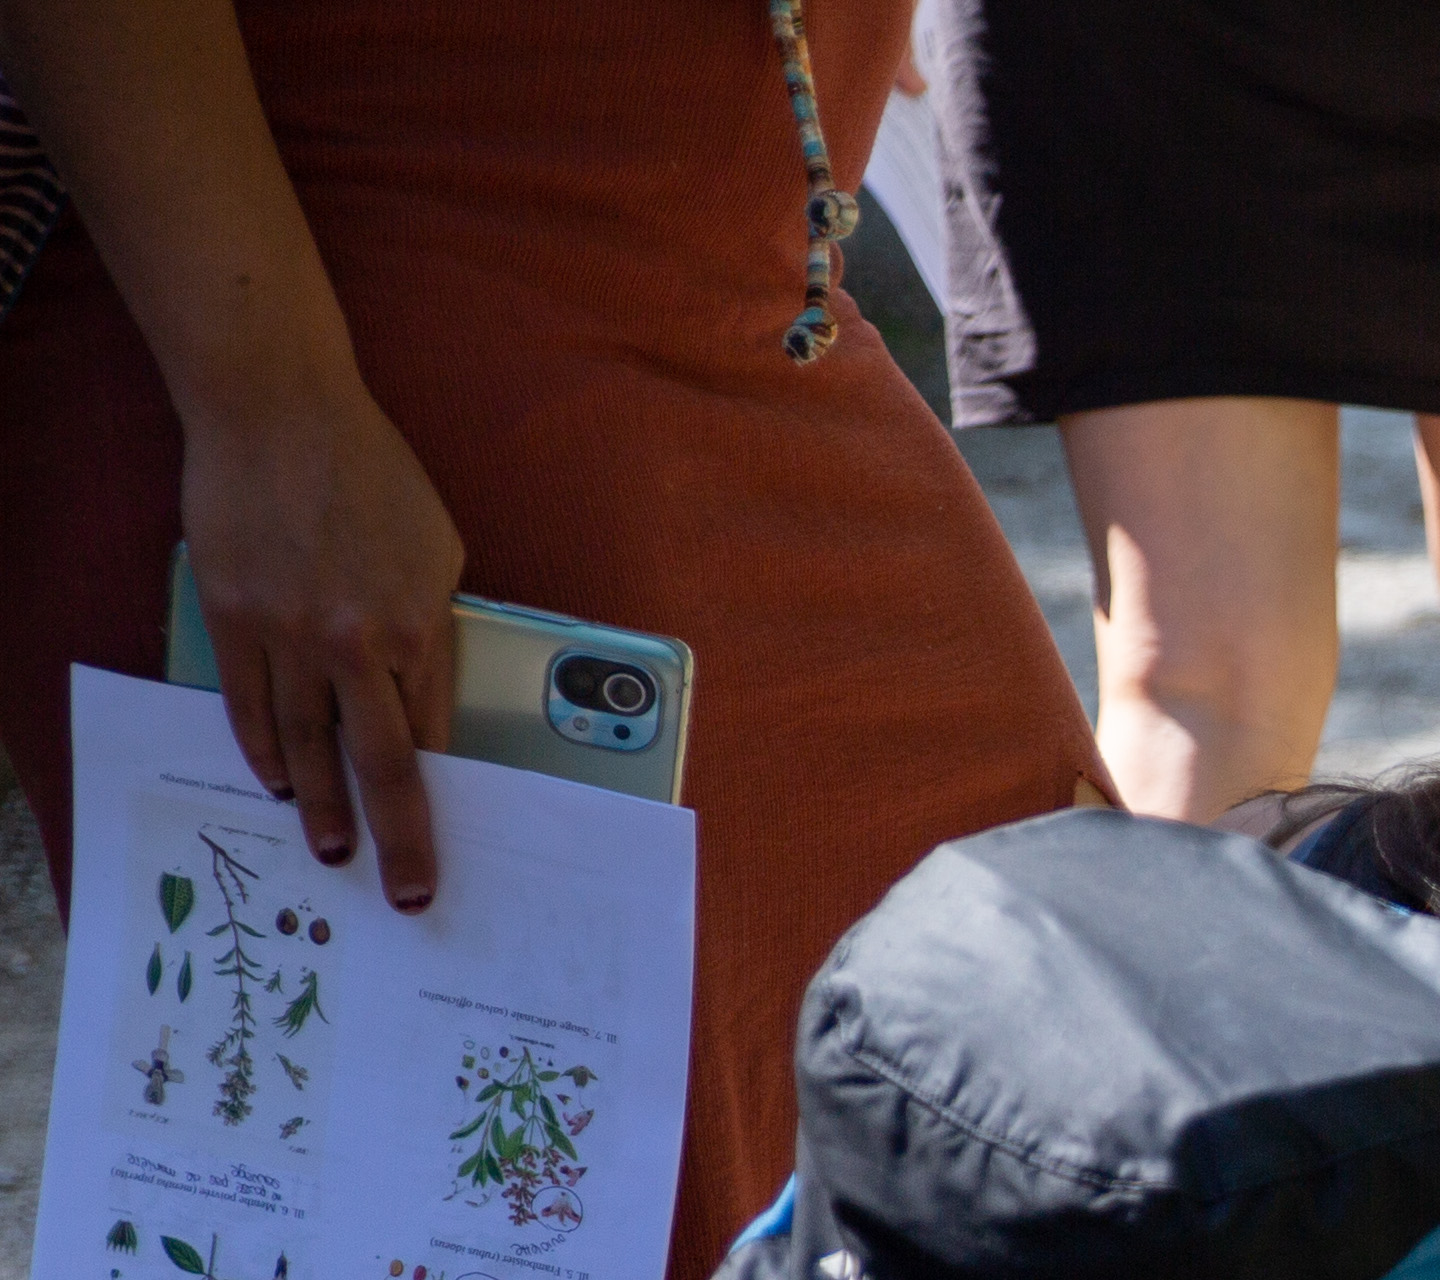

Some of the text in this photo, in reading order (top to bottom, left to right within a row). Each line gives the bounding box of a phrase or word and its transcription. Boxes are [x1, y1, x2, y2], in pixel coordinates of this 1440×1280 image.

[418, 989, 473, 1009] officinalis)
[475, 1003, 509, 1017] (salvia
[511, 1012, 557, 1029] officinale
[559, 1022, 591, 1037] Sauge
[239, 1197, 277, 1212] Menthe
[468, 1247, 500, 1261] (rubus
[502, 1256, 561, 1277] Framboisier
